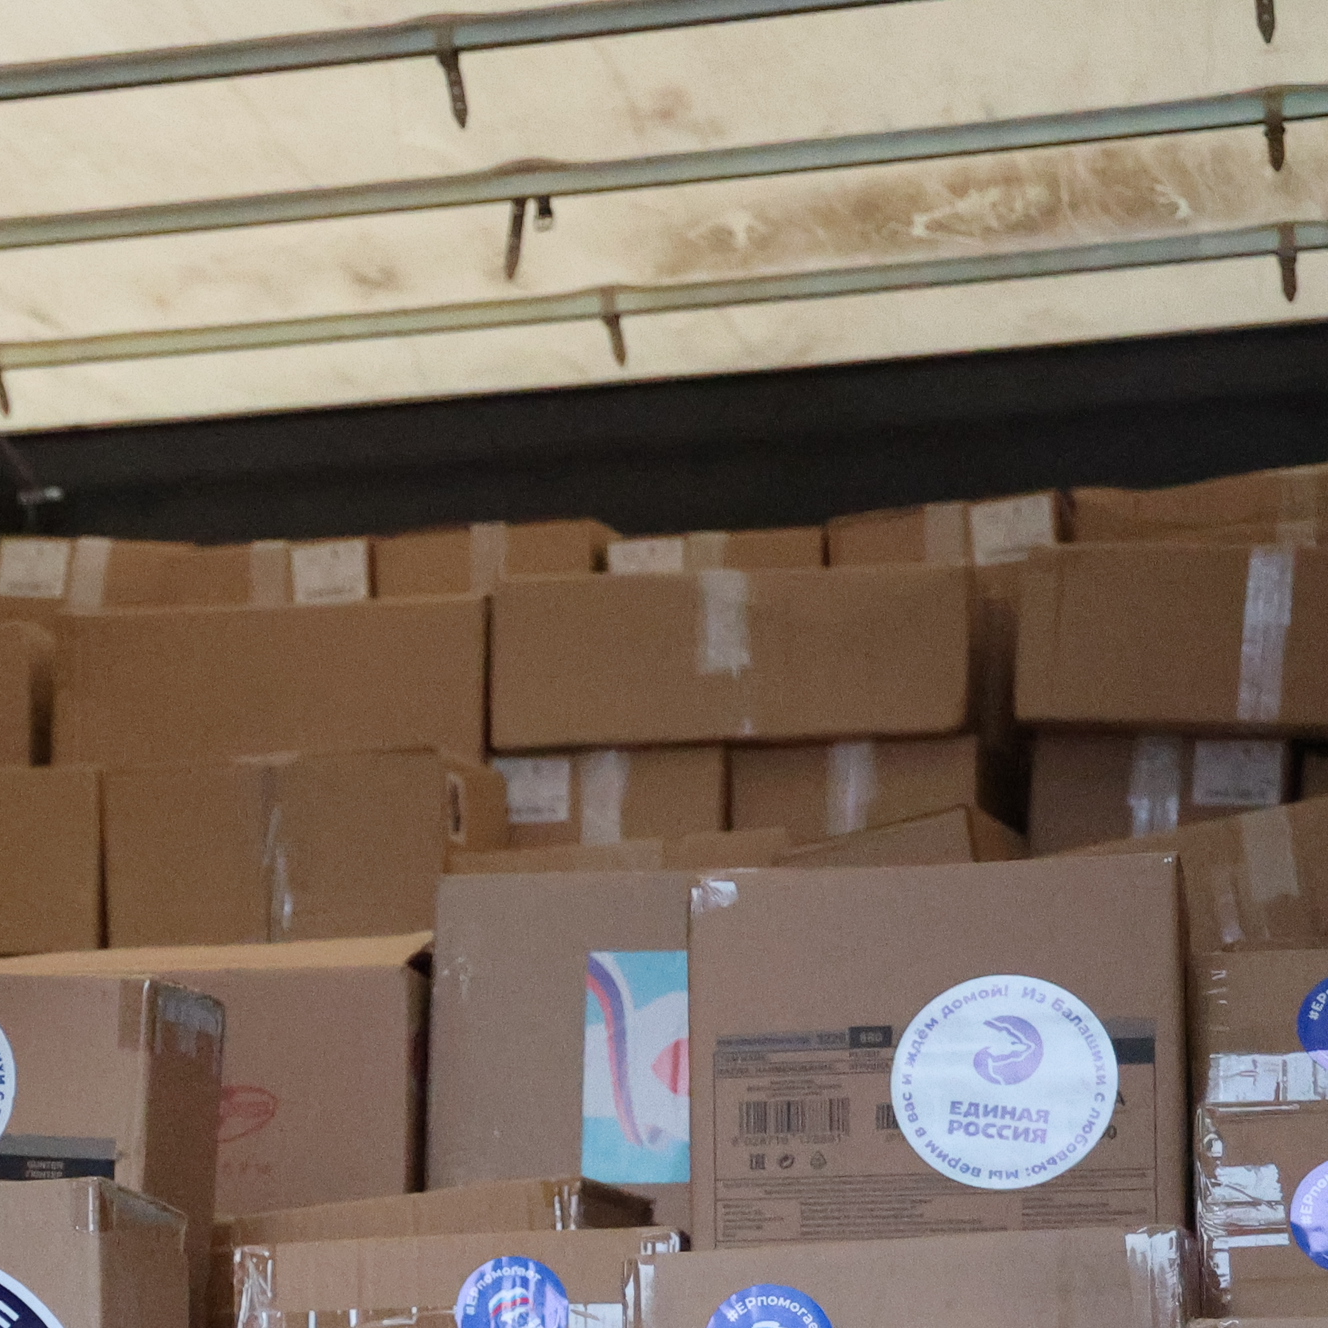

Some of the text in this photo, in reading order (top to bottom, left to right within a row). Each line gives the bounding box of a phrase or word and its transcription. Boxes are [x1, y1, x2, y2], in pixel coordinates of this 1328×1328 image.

[942, 985, 1008, 1019] домой!
[1022, 987, 1046, 1003] Из
[905, 1017, 938, 1068] ждём
[1051, 998, 1107, 1085] Балашихи
[902, 1074, 912, 1085] и
[903, 1092, 919, 1122] вас
[1095, 1093, 1105, 1102] с
[950, 1101, 1050, 1124] ЕДИНАЯ
[915, 1127, 927, 1138] в
[948, 1120, 1047, 1144] РОССИЯ
[1026, 1108, 1101, 1176] любовью:
[925, 1140, 982, 1177] верим
[988, 1169, 1019, 1180] мы
